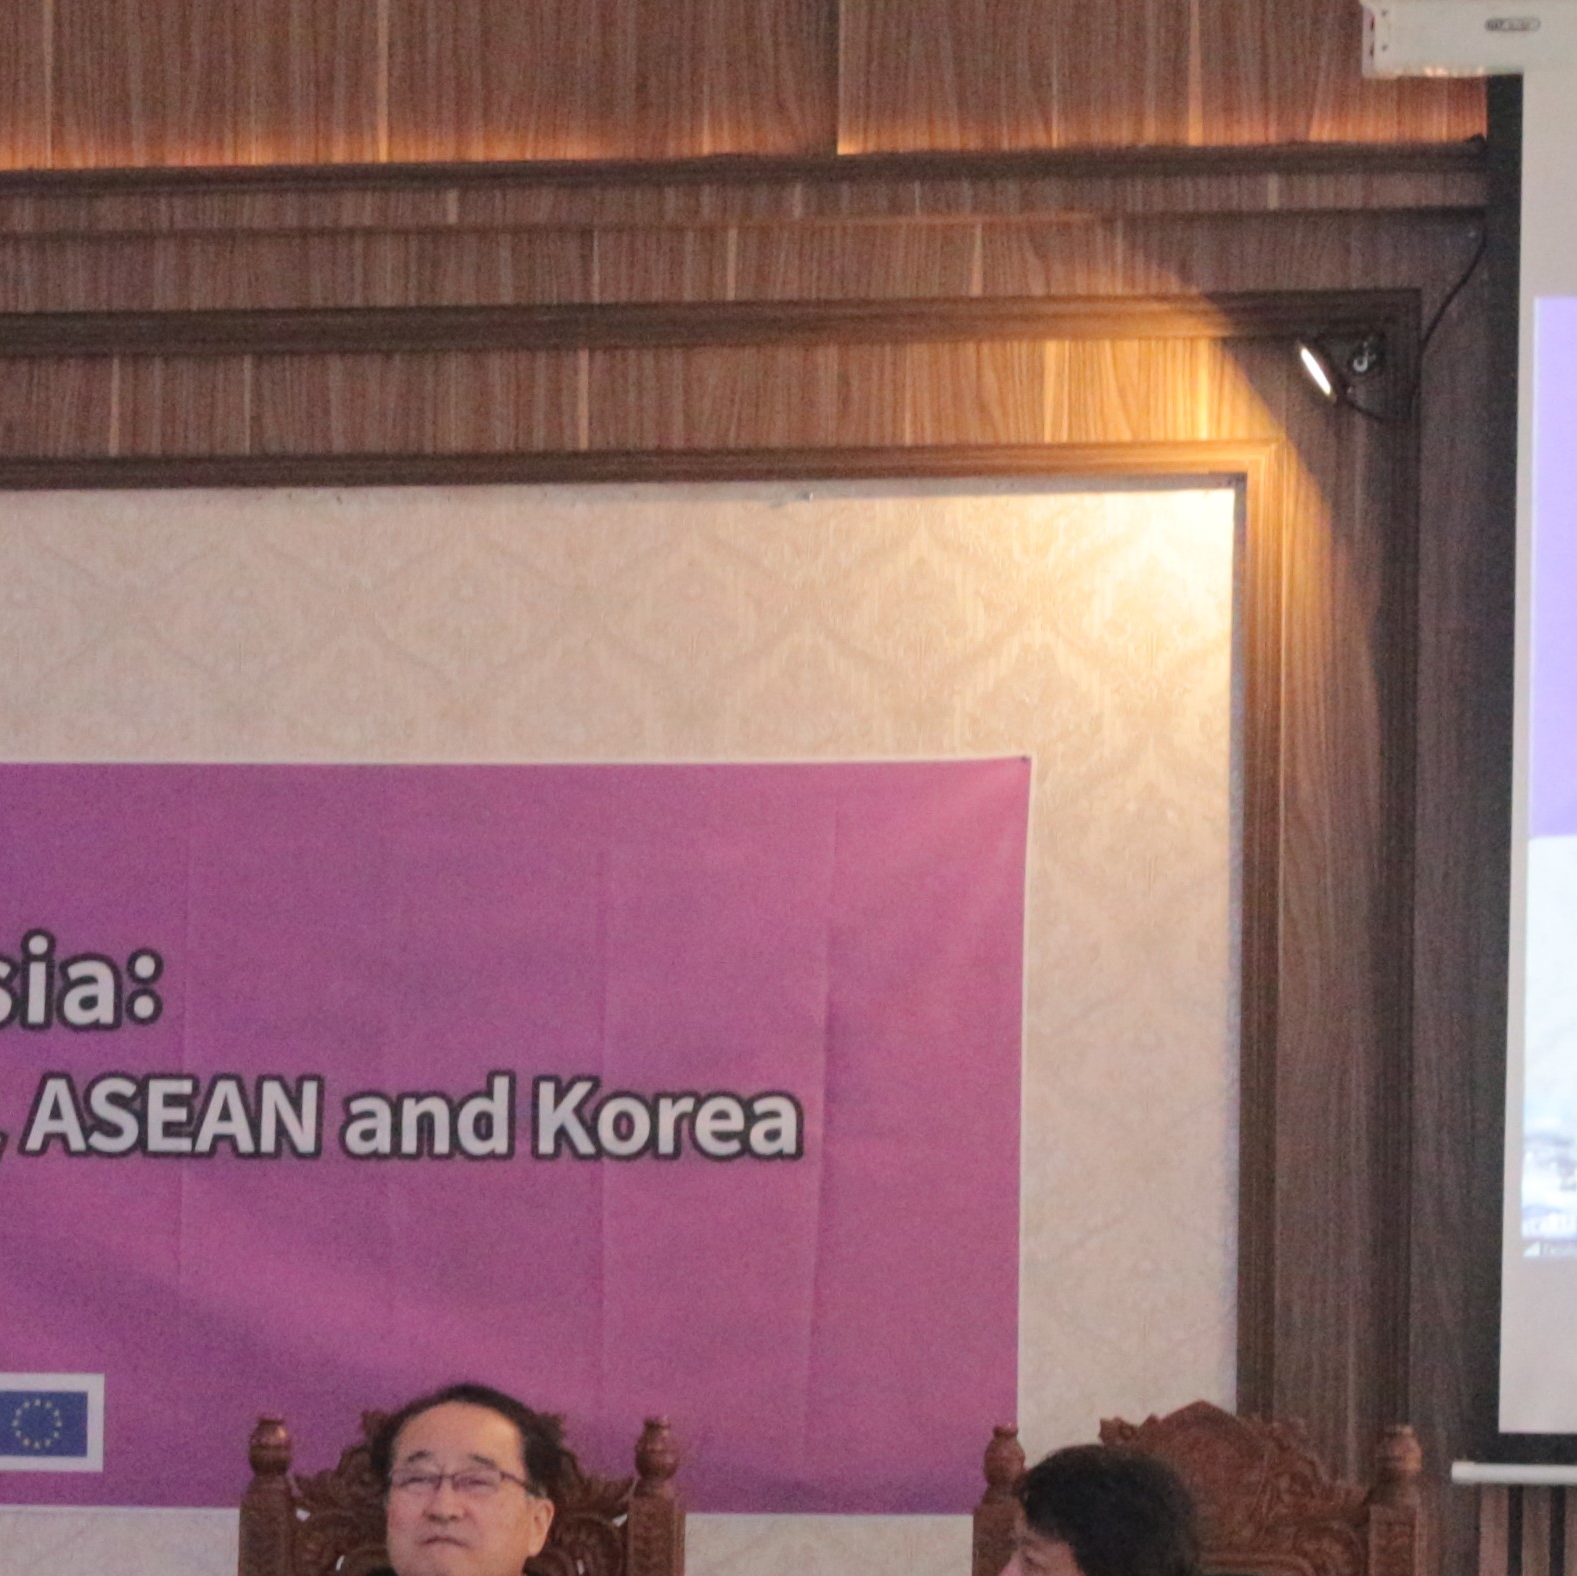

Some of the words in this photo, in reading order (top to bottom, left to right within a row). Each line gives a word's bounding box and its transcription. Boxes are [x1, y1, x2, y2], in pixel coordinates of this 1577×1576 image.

[23, 1076, 321, 1157] ASEAN
[342, 1074, 513, 1160] and
[533, 1077, 802, 1160] Korea
